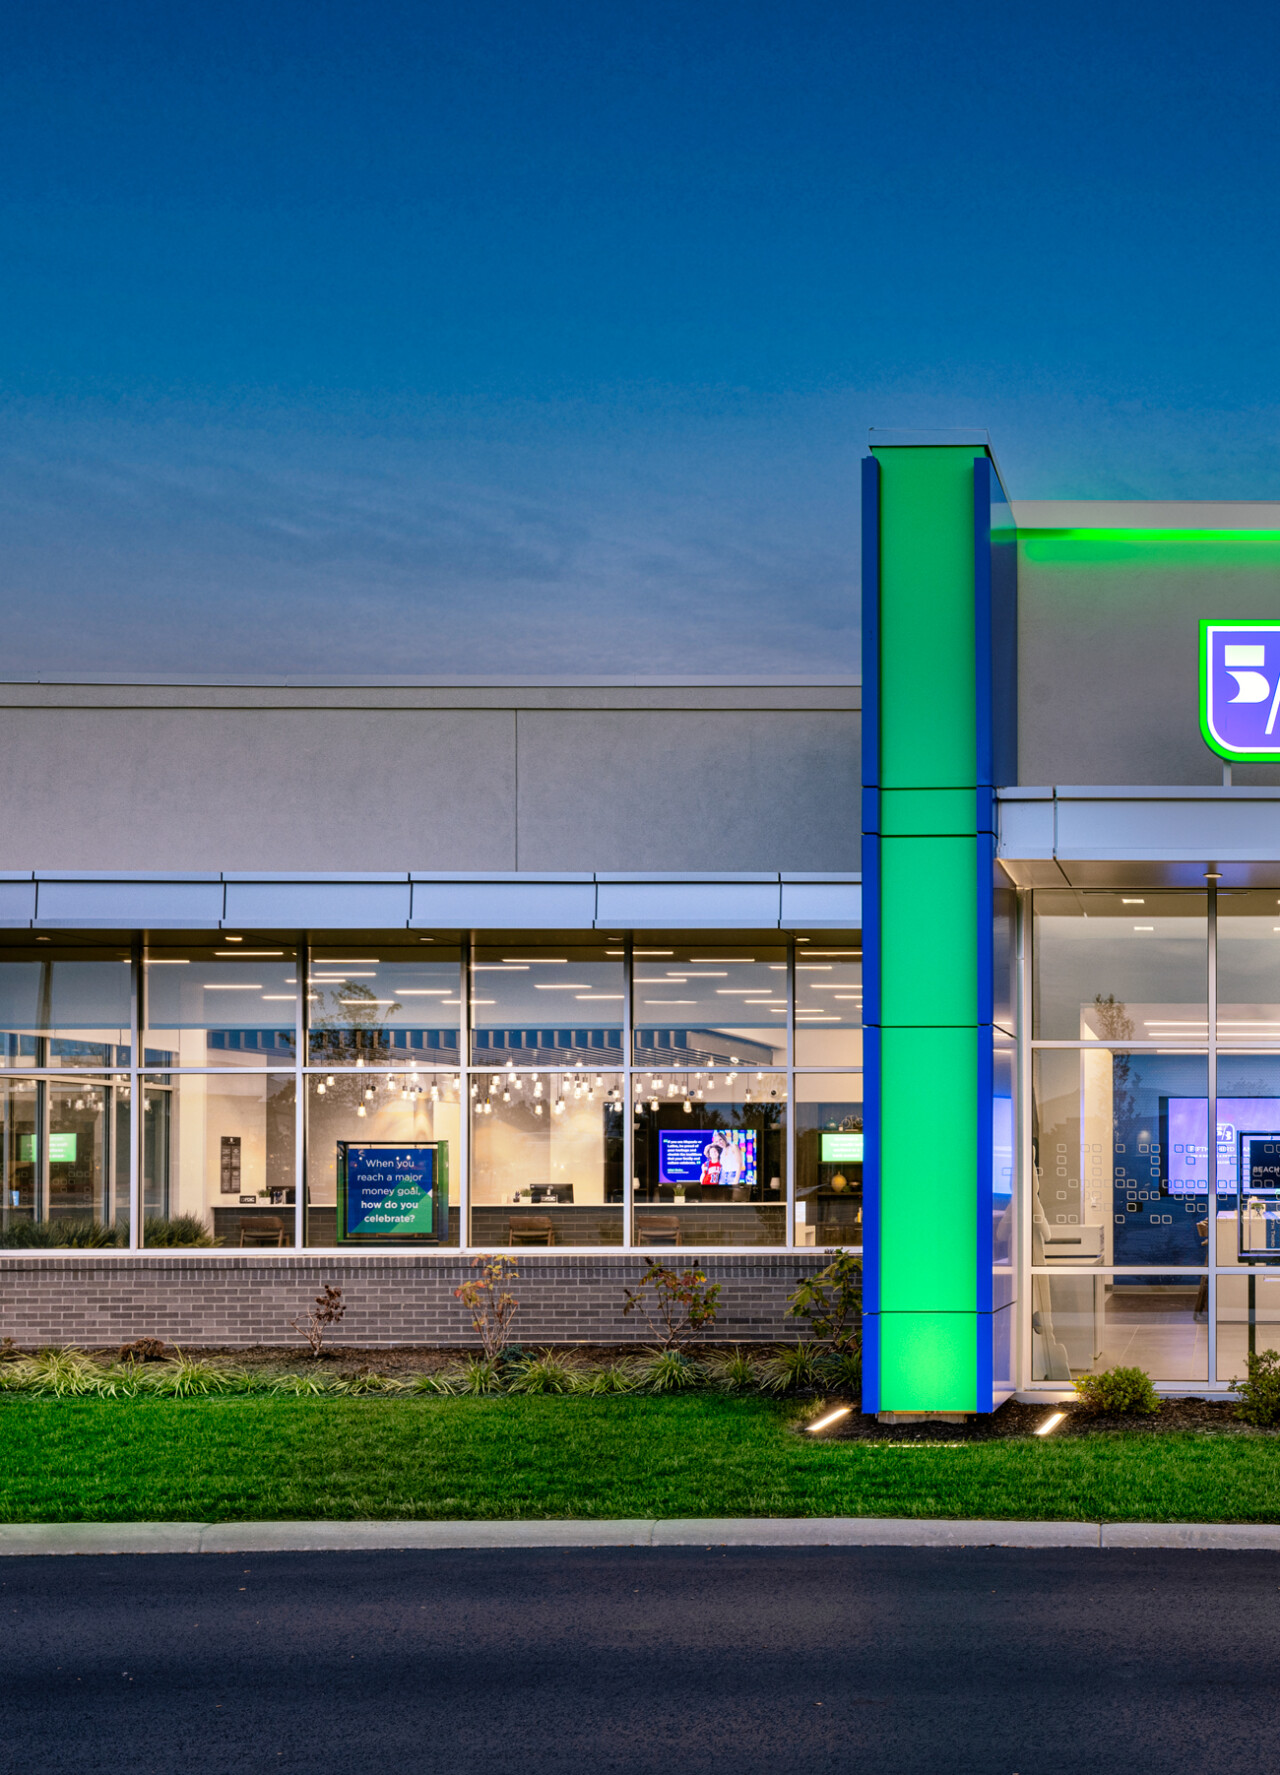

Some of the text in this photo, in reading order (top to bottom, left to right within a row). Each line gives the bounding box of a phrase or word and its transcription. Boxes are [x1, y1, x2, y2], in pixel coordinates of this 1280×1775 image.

[365, 1159, 415, 1169] When you
[357, 1173, 384, 1181] reach
[395, 1173, 423, 1182] major
[361, 1188, 395, 1196] money
[361, 1200, 419, 1210] how do you
[364, 1214, 415, 1223] celebrate?
